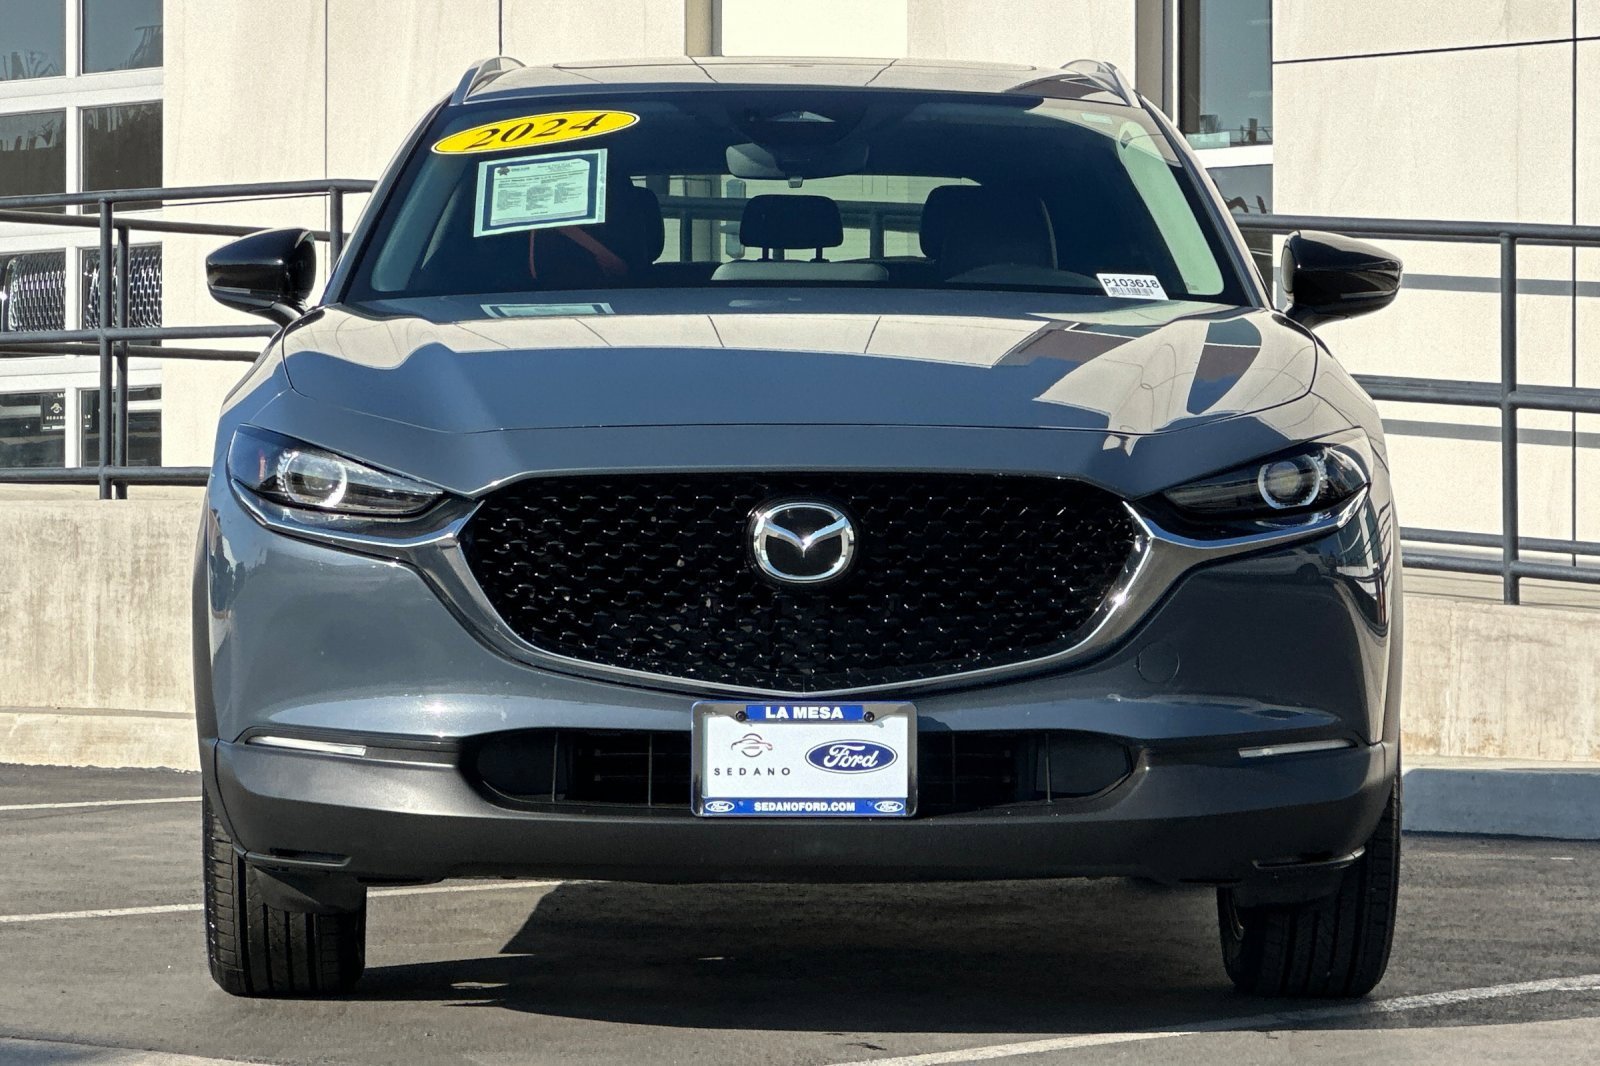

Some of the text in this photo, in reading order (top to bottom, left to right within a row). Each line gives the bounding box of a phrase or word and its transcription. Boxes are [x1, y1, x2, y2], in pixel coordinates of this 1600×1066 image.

[464, 113, 607, 149] 2024
[1102, 278, 1160, 289] P103618
[765, 706, 844, 719] LA MESA
[823, 743, 879, 768] Ford
[713, 767, 791, 776] SEDANO
[753, 801, 856, 812] SEDANOFORD.COM
